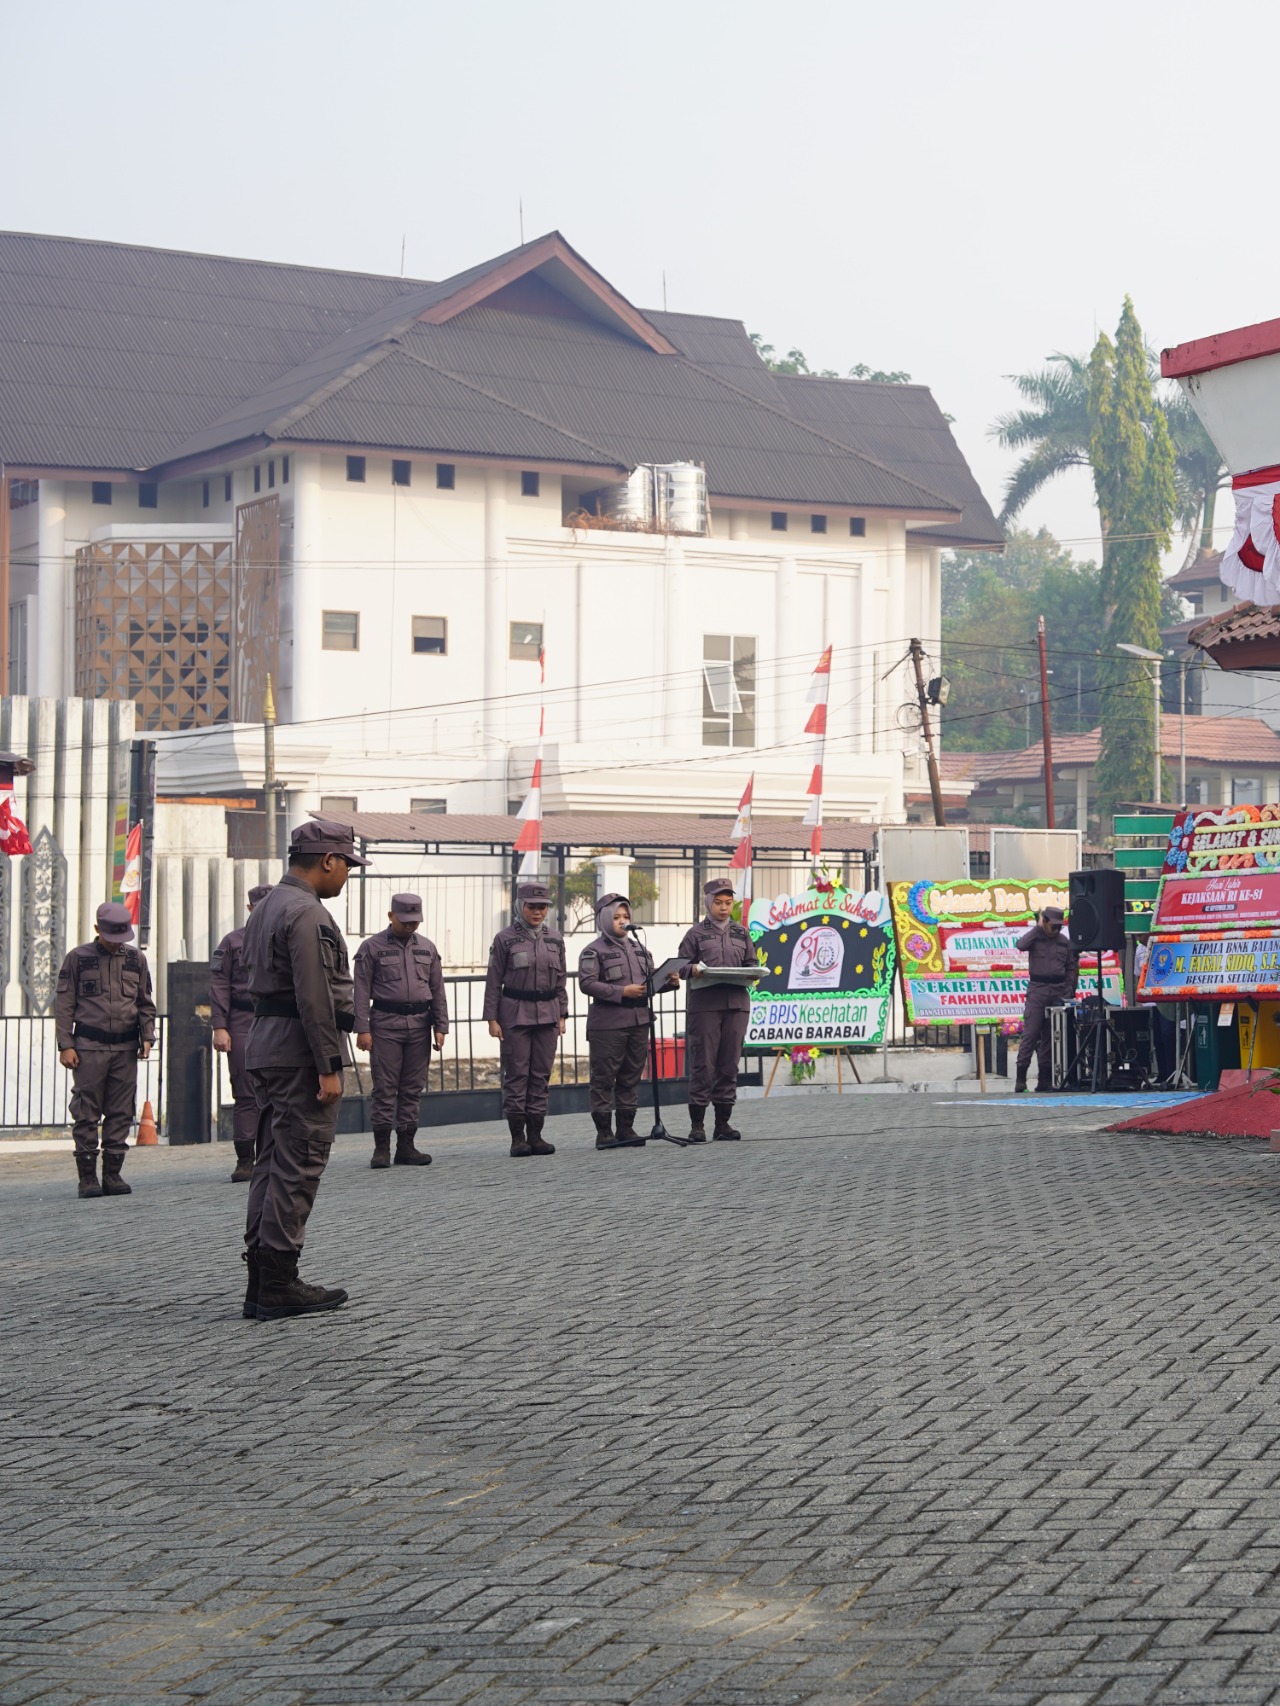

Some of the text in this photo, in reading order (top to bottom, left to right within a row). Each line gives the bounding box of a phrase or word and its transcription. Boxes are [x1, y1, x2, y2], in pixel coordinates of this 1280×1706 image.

[1193, 830, 1247, 851] SELAMAT
[1206, 878, 1224, 892] Hari
[930, 888, 992, 915] Selamat
[993, 887, 1027, 912] Dan
[1181, 889, 1263, 906] KEJAKSAAN RI KE-81
[769, 890, 881, 926] Selamat & Sukses
[954, 936, 1010, 951] KEJAKSAAN
[1191, 942, 1224, 956] KEPALA
[1225, 941, 1248, 954] BNNK
[1173, 955, 1187, 974] M.
[1187, 954, 1223, 973] FAISAL
[1225, 953, 1257, 973] SIDIQ,
[917, 979, 1029, 994] SEKRETARIS
[1185, 974, 1225, 985] BESERTA
[1226, 972, 1266, 984] SELURUH
[940, 993, 1027, 1006] FAKHRIYANT
[769, 1003, 868, 1026] BPJS Kesehatan
[749, 1025, 866, 1041] CABANG BARABAI
